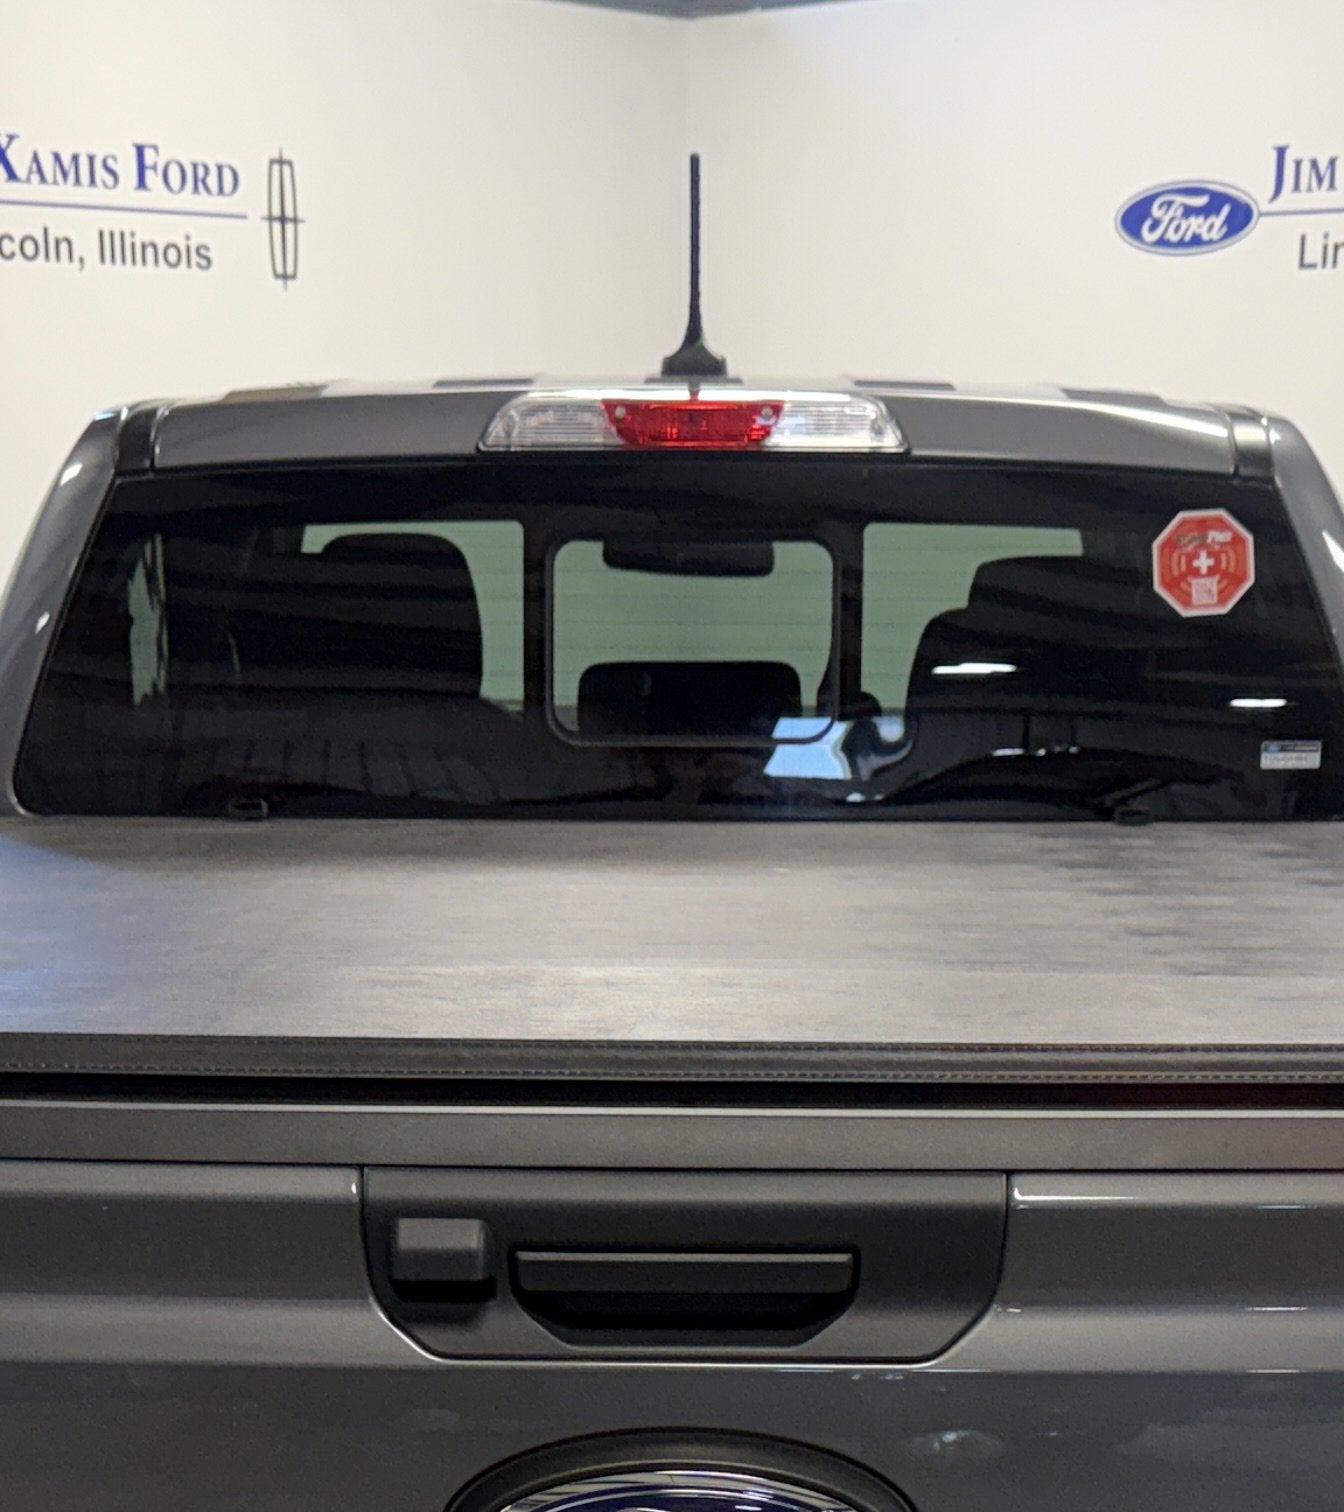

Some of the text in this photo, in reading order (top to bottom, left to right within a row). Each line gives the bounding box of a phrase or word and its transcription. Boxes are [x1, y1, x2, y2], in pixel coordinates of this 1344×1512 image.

[132, 143, 240, 197] FORD
[1268, 145, 1338, 204] JIM
[1141, 192, 1228, 243] Ford
[98, 228, 213, 271] Illinois
